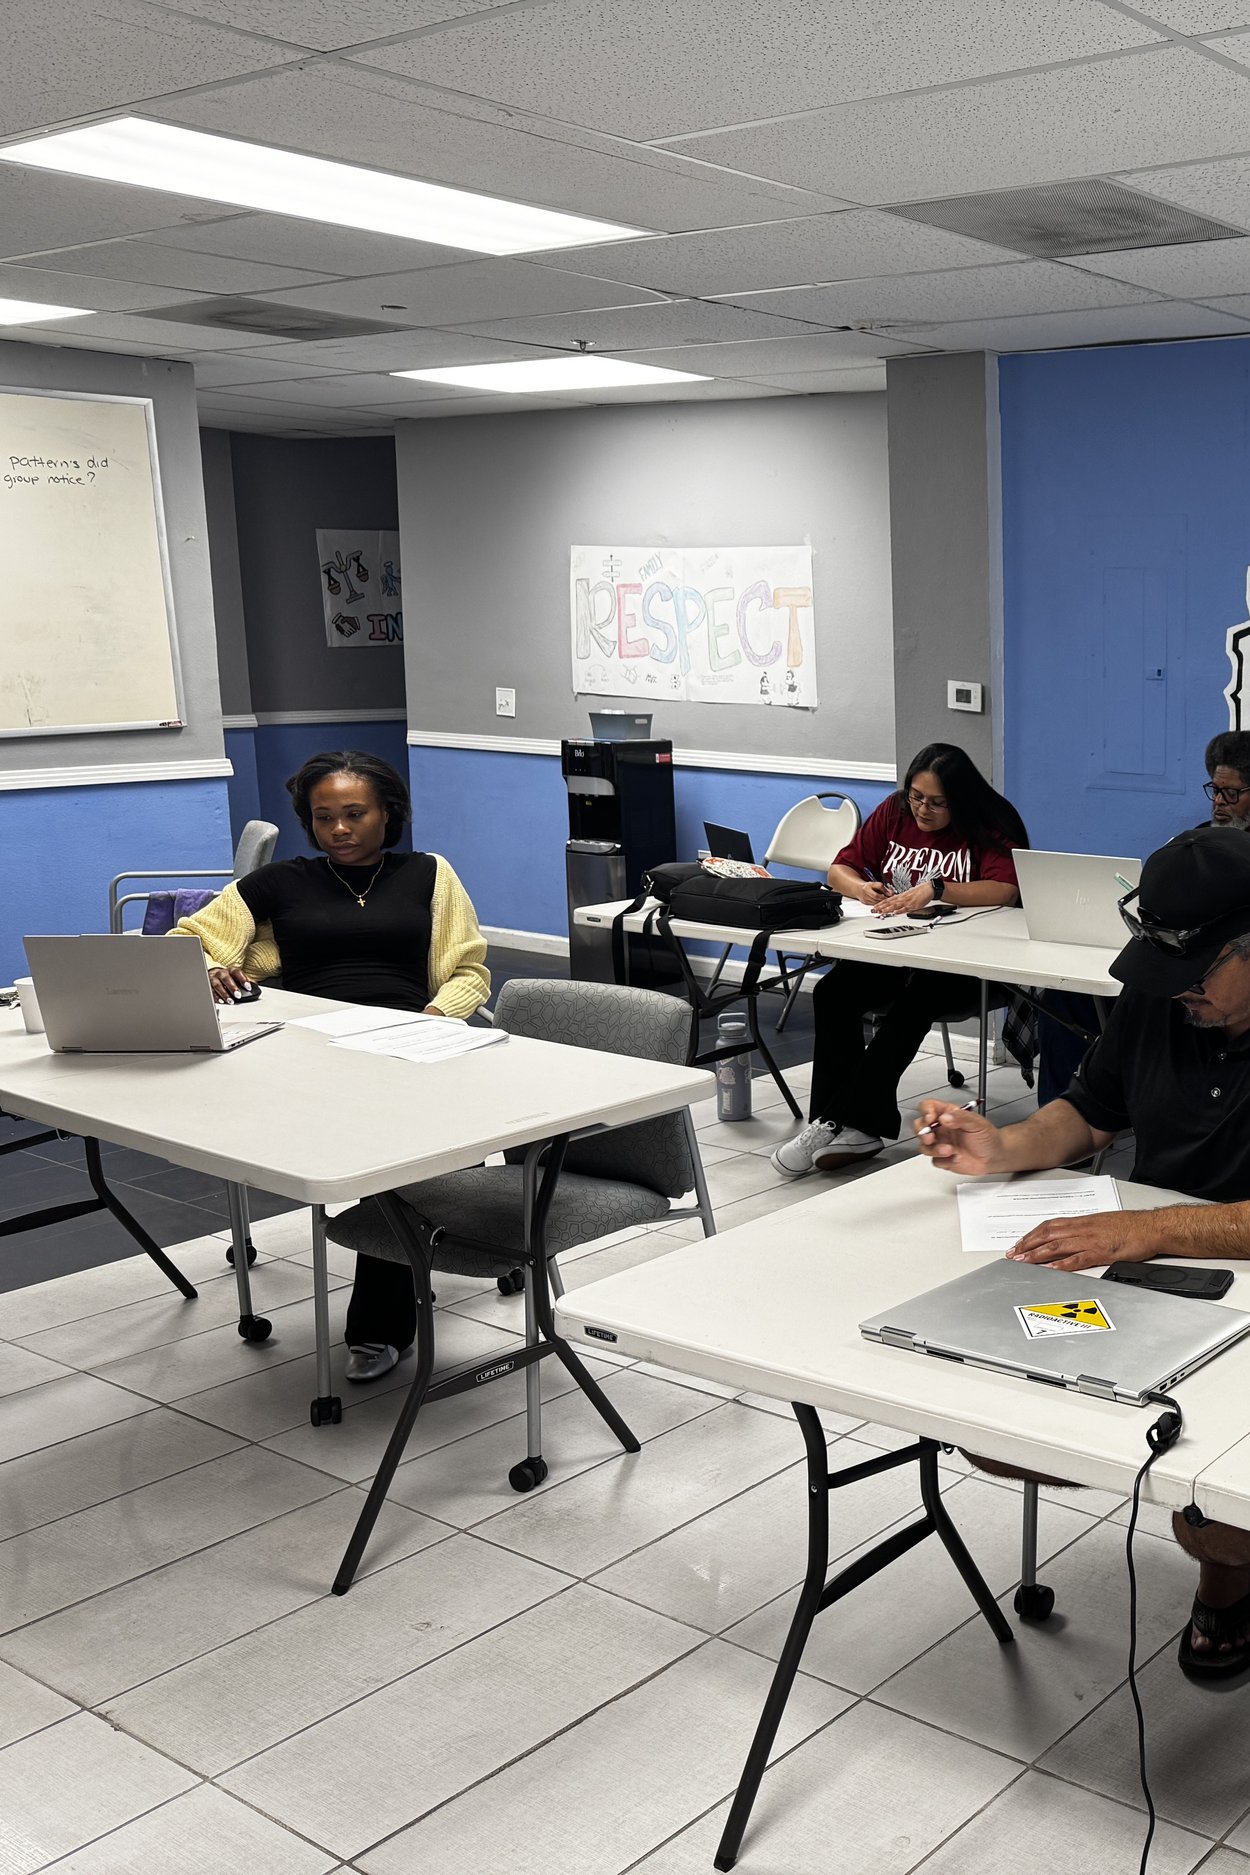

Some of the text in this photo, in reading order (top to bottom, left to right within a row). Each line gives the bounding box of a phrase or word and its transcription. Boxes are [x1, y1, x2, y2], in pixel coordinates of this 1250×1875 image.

[87, 455, 109, 469] did
[4, 474, 39, 489] group
[575, 578, 812, 675] RESPECT
[881, 840, 971, 883] REEDOM
[1028, 1312, 1081, 1328] RADIOACTIVE
[588, 1327, 614, 1340] LIFETIME
[480, 1363, 510, 1380] LIFETIME
